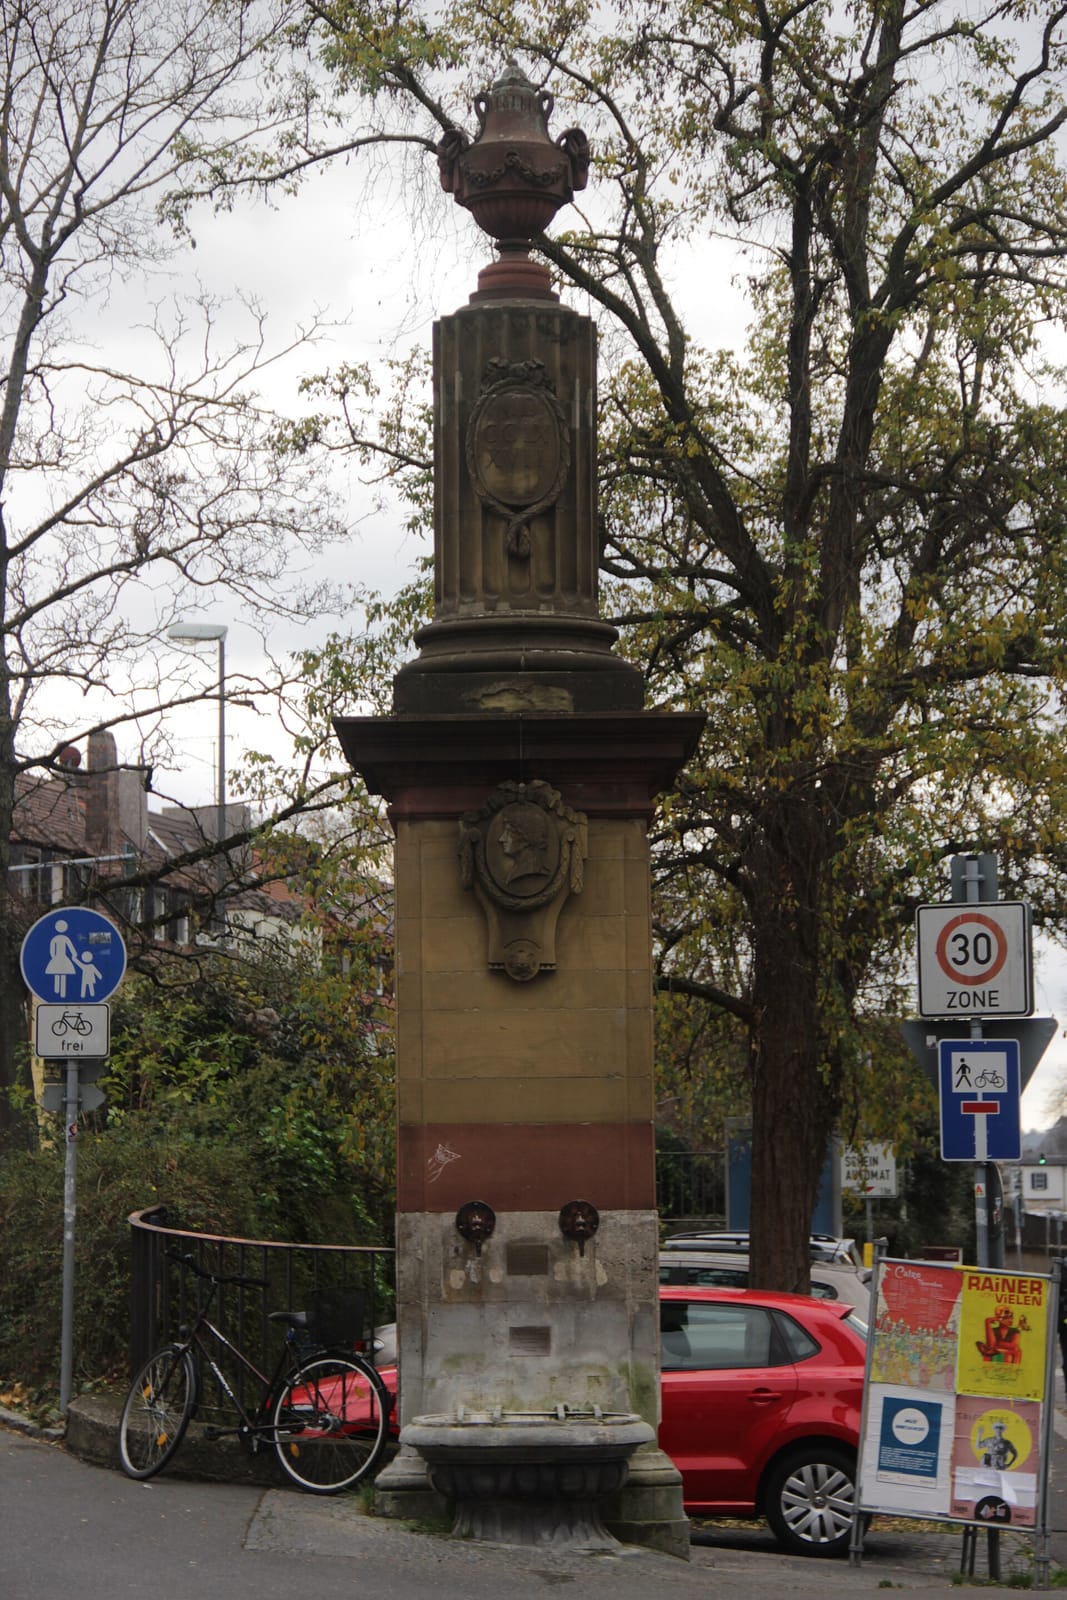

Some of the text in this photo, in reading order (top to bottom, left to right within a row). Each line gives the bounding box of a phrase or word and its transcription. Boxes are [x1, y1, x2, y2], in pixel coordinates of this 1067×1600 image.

[951, 932, 992, 966] 30
[946, 990, 1000, 1009] ZONE
[61, 1039, 84, 1051] frei
